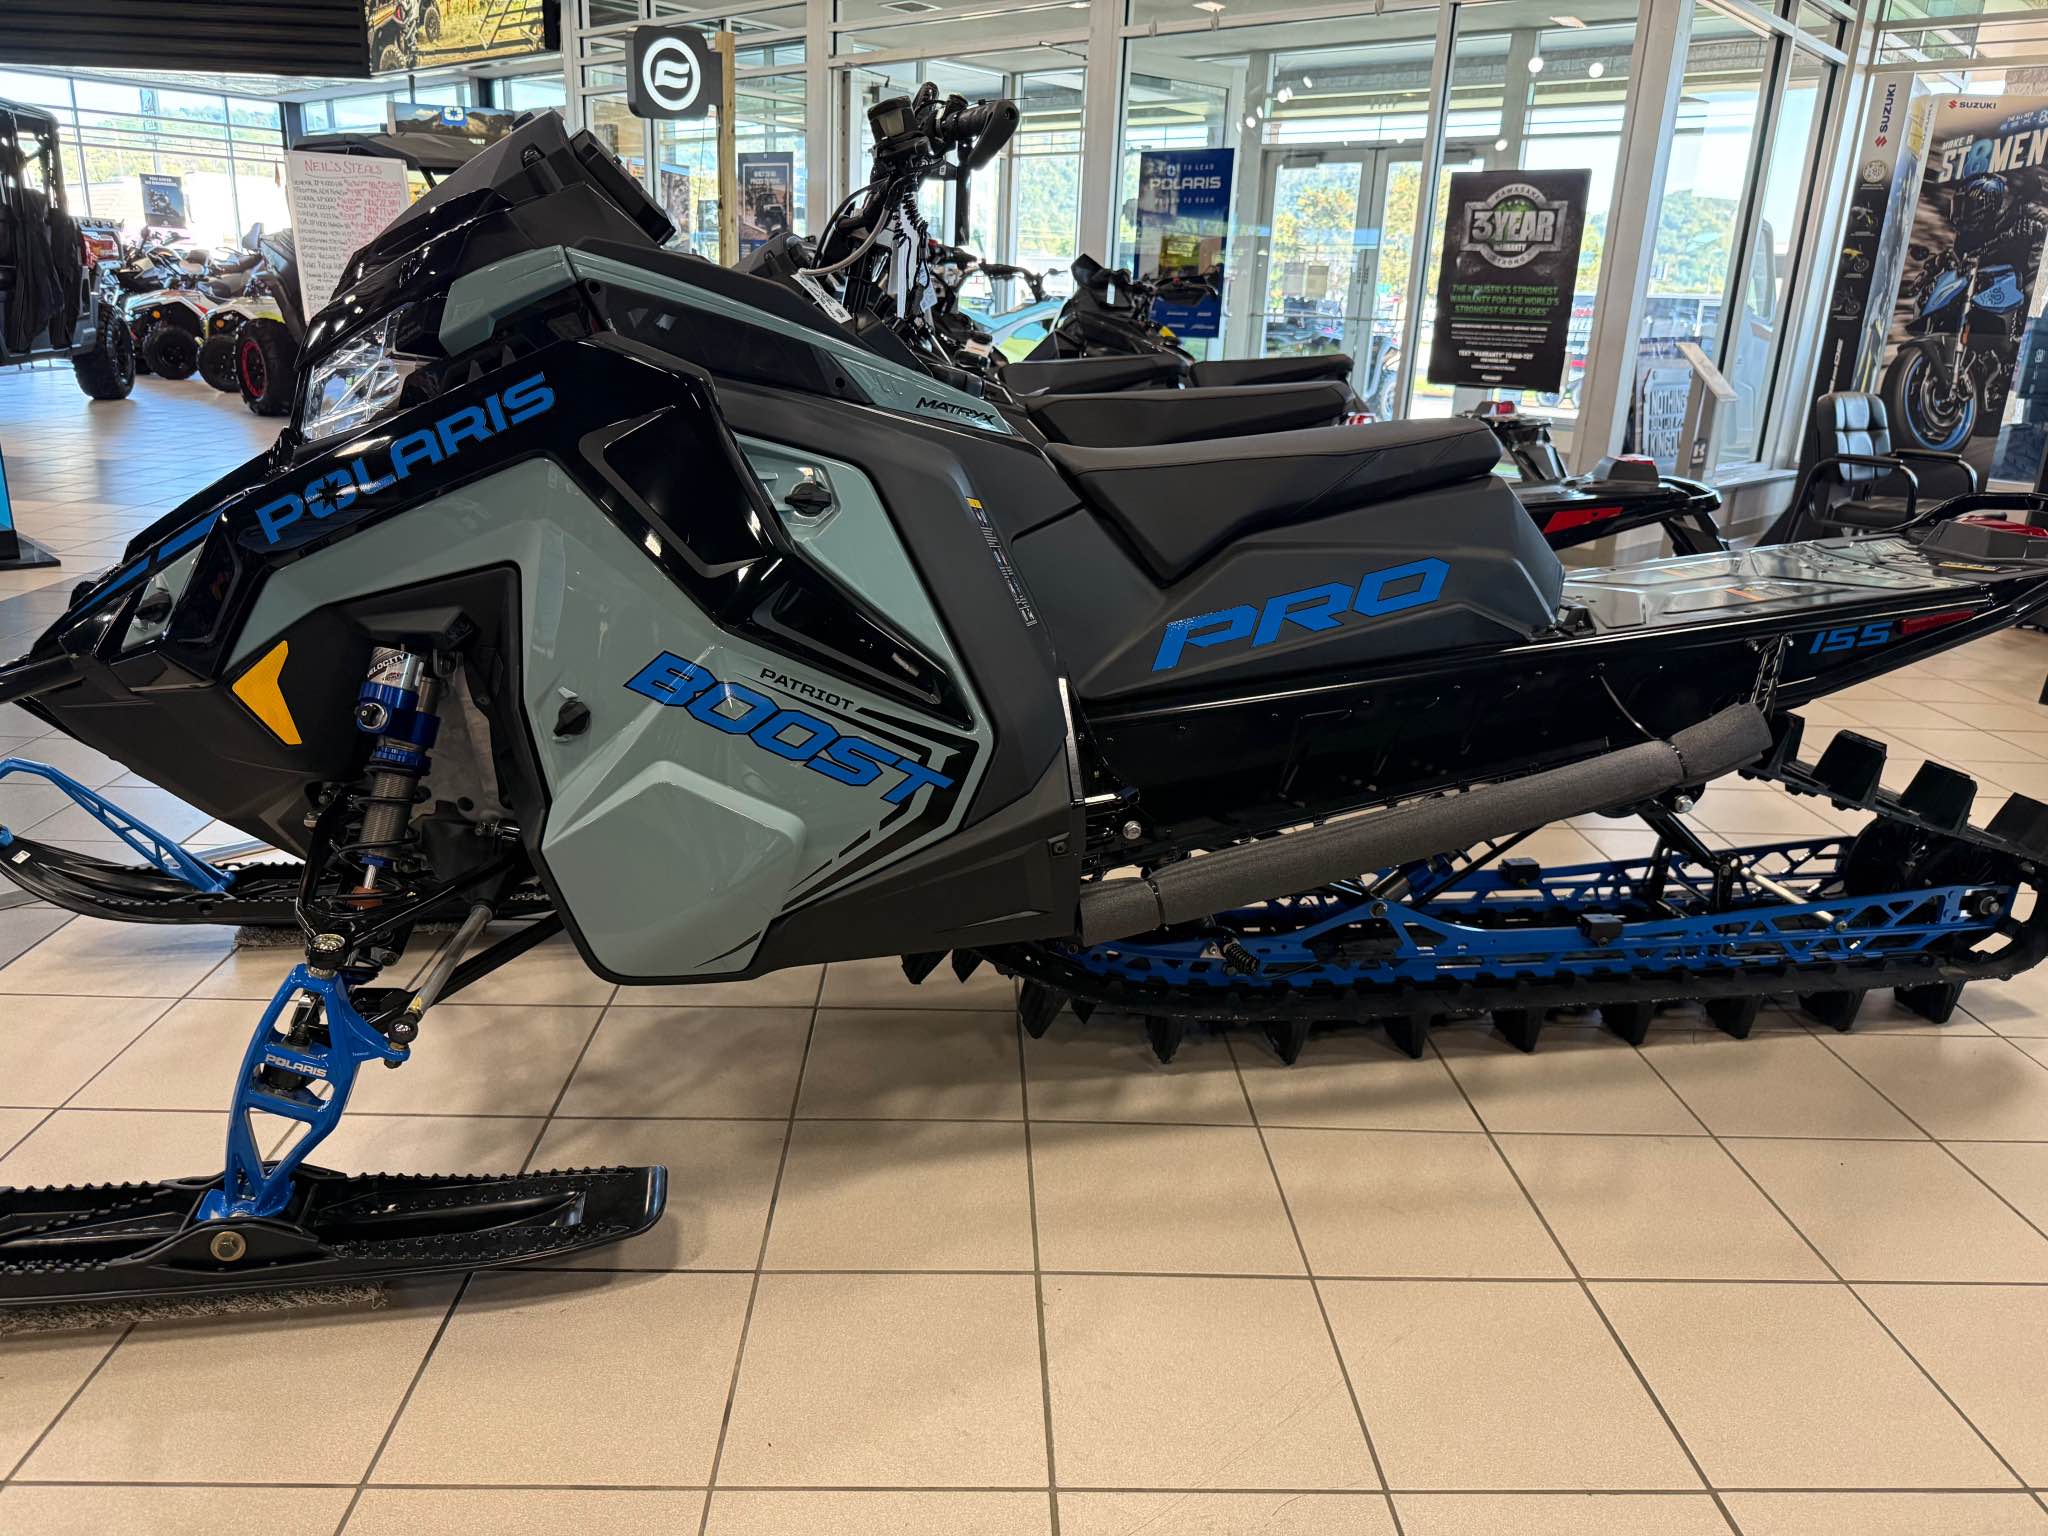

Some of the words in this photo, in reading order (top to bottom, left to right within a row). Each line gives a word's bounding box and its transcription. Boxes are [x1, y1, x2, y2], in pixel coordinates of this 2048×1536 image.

[1880, 83, 1897, 133] SUZUKI
[1959, 101, 1997, 109] SUZUKI
[1942, 137, 1965, 150] MAKE
[1967, 134, 1974, 145] A
[1150, 176, 1221, 190] POLARIS
[1494, 186, 1541, 201] KAWASAKI
[1494, 210, 1555, 242] YEAR
[1453, 284, 1466, 292] THE
[1512, 286, 1559, 295] STRONGEST
[1509, 296, 1523, 304] THE
[1524, 297, 1560, 306] WORLD'S
[1455, 305, 1498, 314] STRONGEST
[915, 397, 995, 425] MATRYX
[255, 371, 556, 545] POLARIS
[1151, 556, 1450, 672] PRO
[1809, 621, 1895, 655] 155
[759, 667, 854, 711] PATRIOT
[623, 650, 955, 805] BOOST
[264, 1053, 328, 1078] POLARIS
